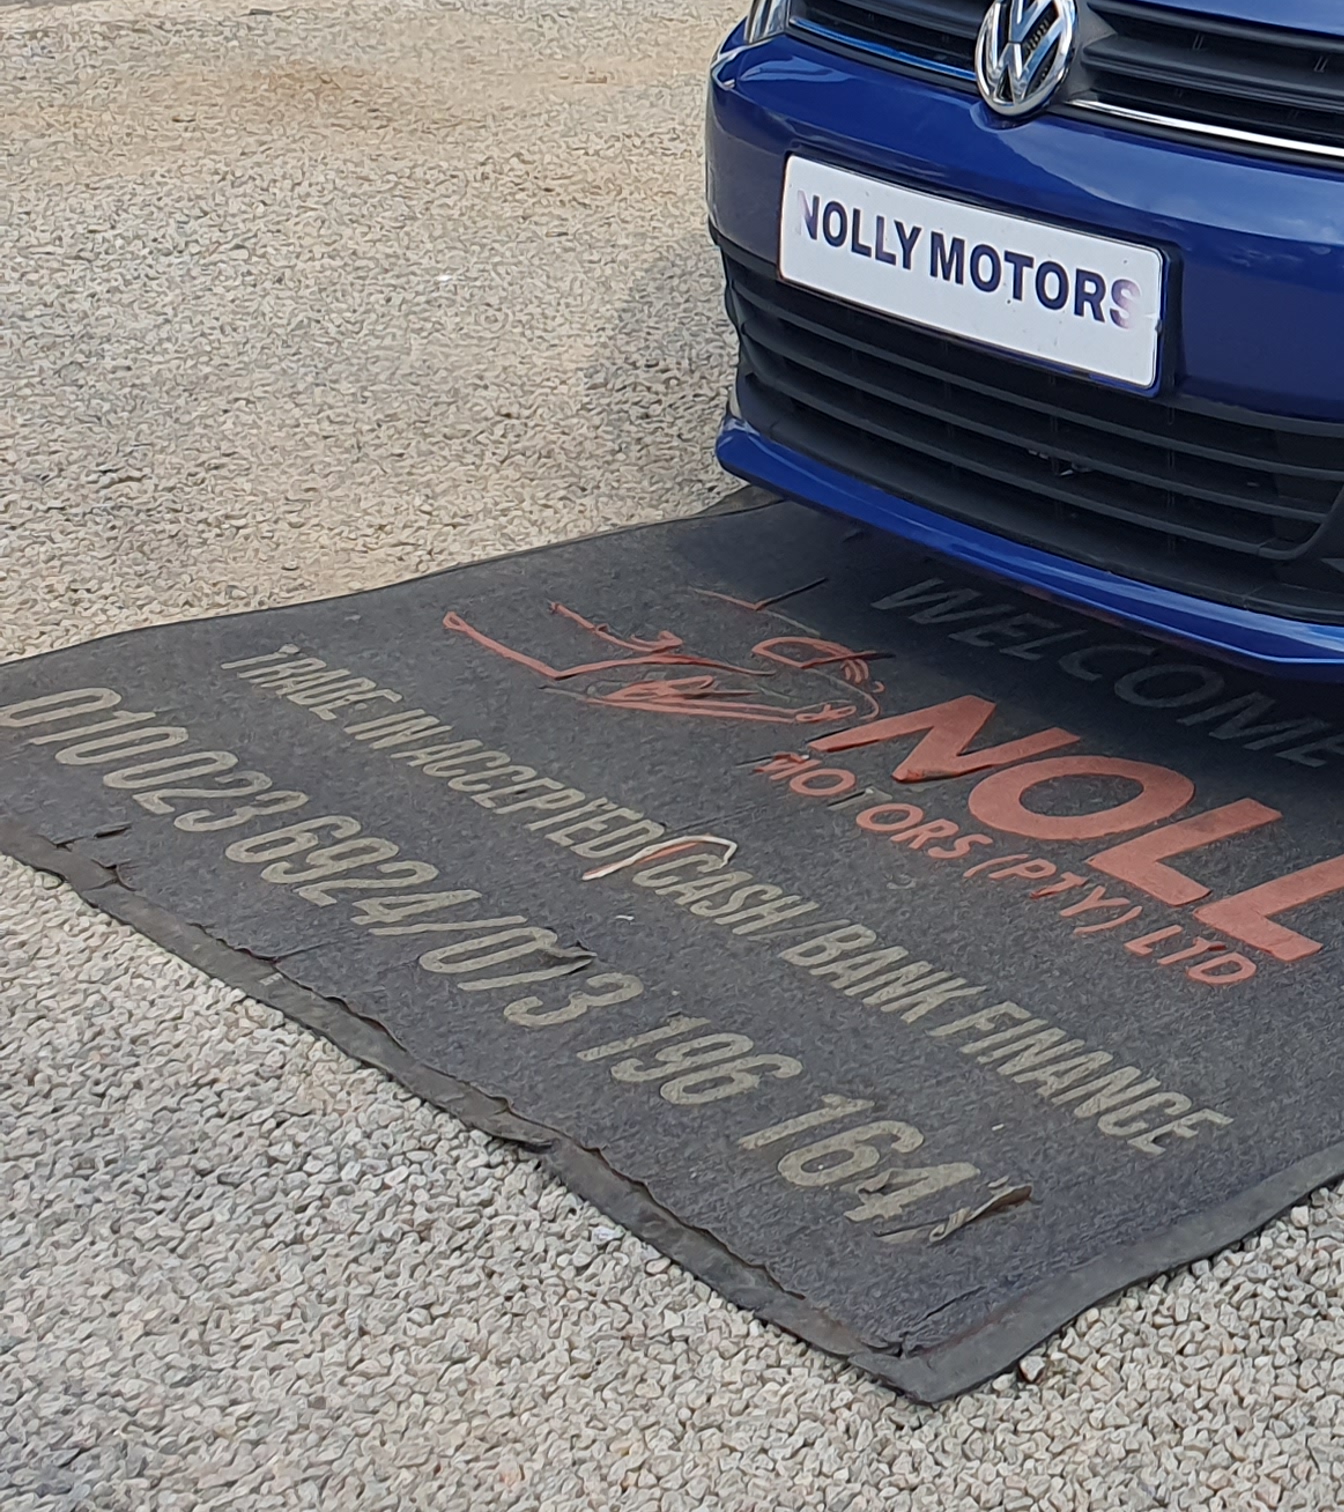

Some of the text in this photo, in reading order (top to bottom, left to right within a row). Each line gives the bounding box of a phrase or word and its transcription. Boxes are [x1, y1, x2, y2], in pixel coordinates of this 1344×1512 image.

[796, 189, 1142, 329] NOLLY MOTORS
[220, 643, 403, 721] TRADE
[343, 708, 454, 750] IN
[929, 1001, 1235, 1156] FINANCE
[1124, 924, 1257, 985] LTD
[575, 1015, 803, 1106] 196
